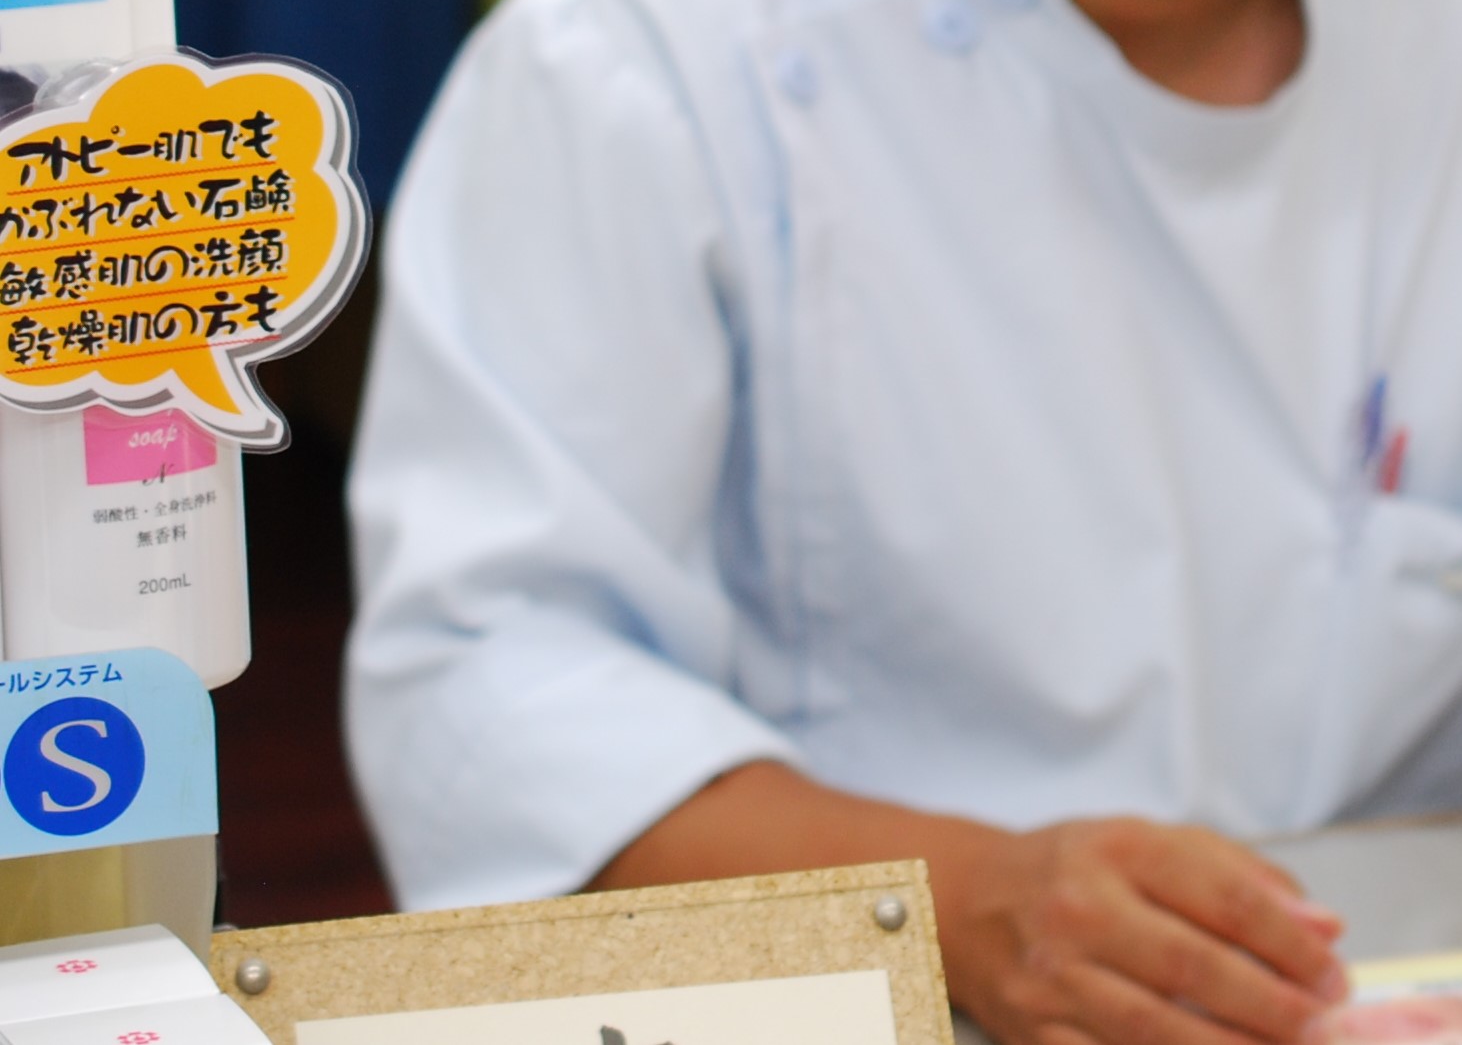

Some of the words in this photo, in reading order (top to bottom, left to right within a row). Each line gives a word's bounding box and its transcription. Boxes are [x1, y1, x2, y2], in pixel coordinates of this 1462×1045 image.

[7, 110, 276, 186] アトピー肌でも
[0, 228, 284, 306] 敏感肌の洗顔
[7, 285, 280, 365] 乾燥肌の方も
[127, 423, 178, 449] soap
[137, 524, 187, 547] 無香料
[138, 573, 192, 595] 200mL
[40, 719, 112, 812] S
